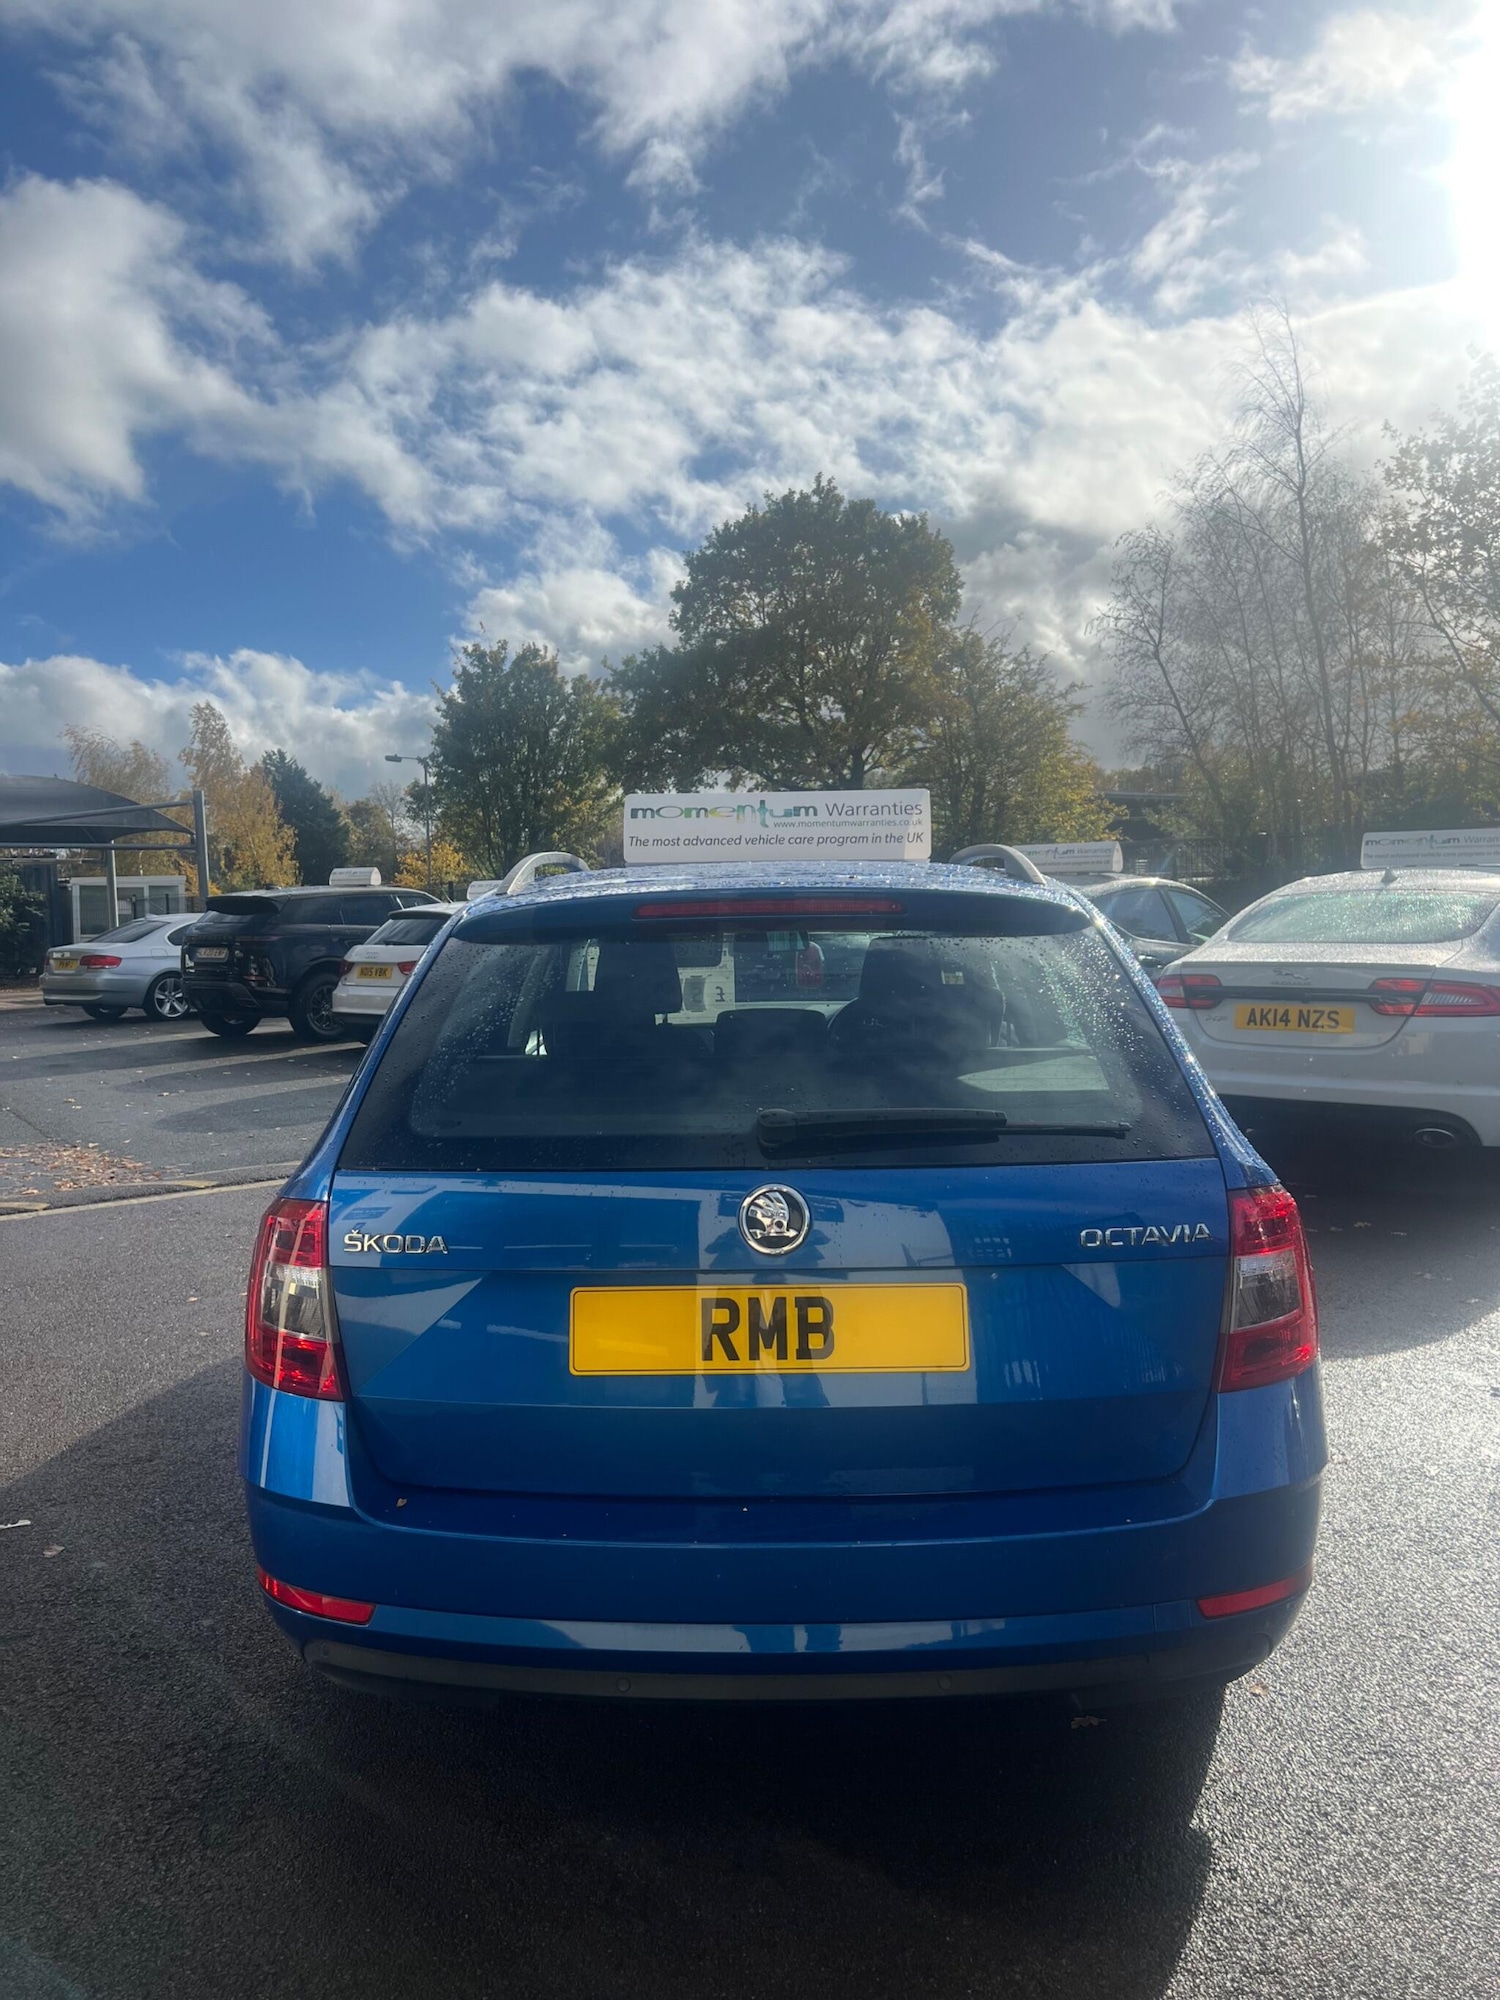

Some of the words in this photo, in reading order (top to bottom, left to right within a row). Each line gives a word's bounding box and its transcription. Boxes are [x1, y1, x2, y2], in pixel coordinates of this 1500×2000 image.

[630, 799, 818, 828] momentum
[825, 801, 923, 817] Warranties
[773, 818, 923, 828] www.momentumwarranties.co.uk
[629, 836, 649, 847] The
[652, 836, 681, 847] most
[683, 835, 742, 846] advanced
[745, 834, 785, 846] vehicle
[788, 835, 814, 845] care
[817, 835, 868, 847] program
[872, 833, 882, 844] in
[885, 833, 903, 844] the
[907, 832, 924, 844] UK
[1246, 1008, 1291, 1028] AK14
[1297, 1009, 1340, 1030] NZS
[343, 1229, 449, 1254] ŠKODA
[1079, 1223, 1214, 1247] OCTAVIA
[701, 1296, 835, 1362] RMB
